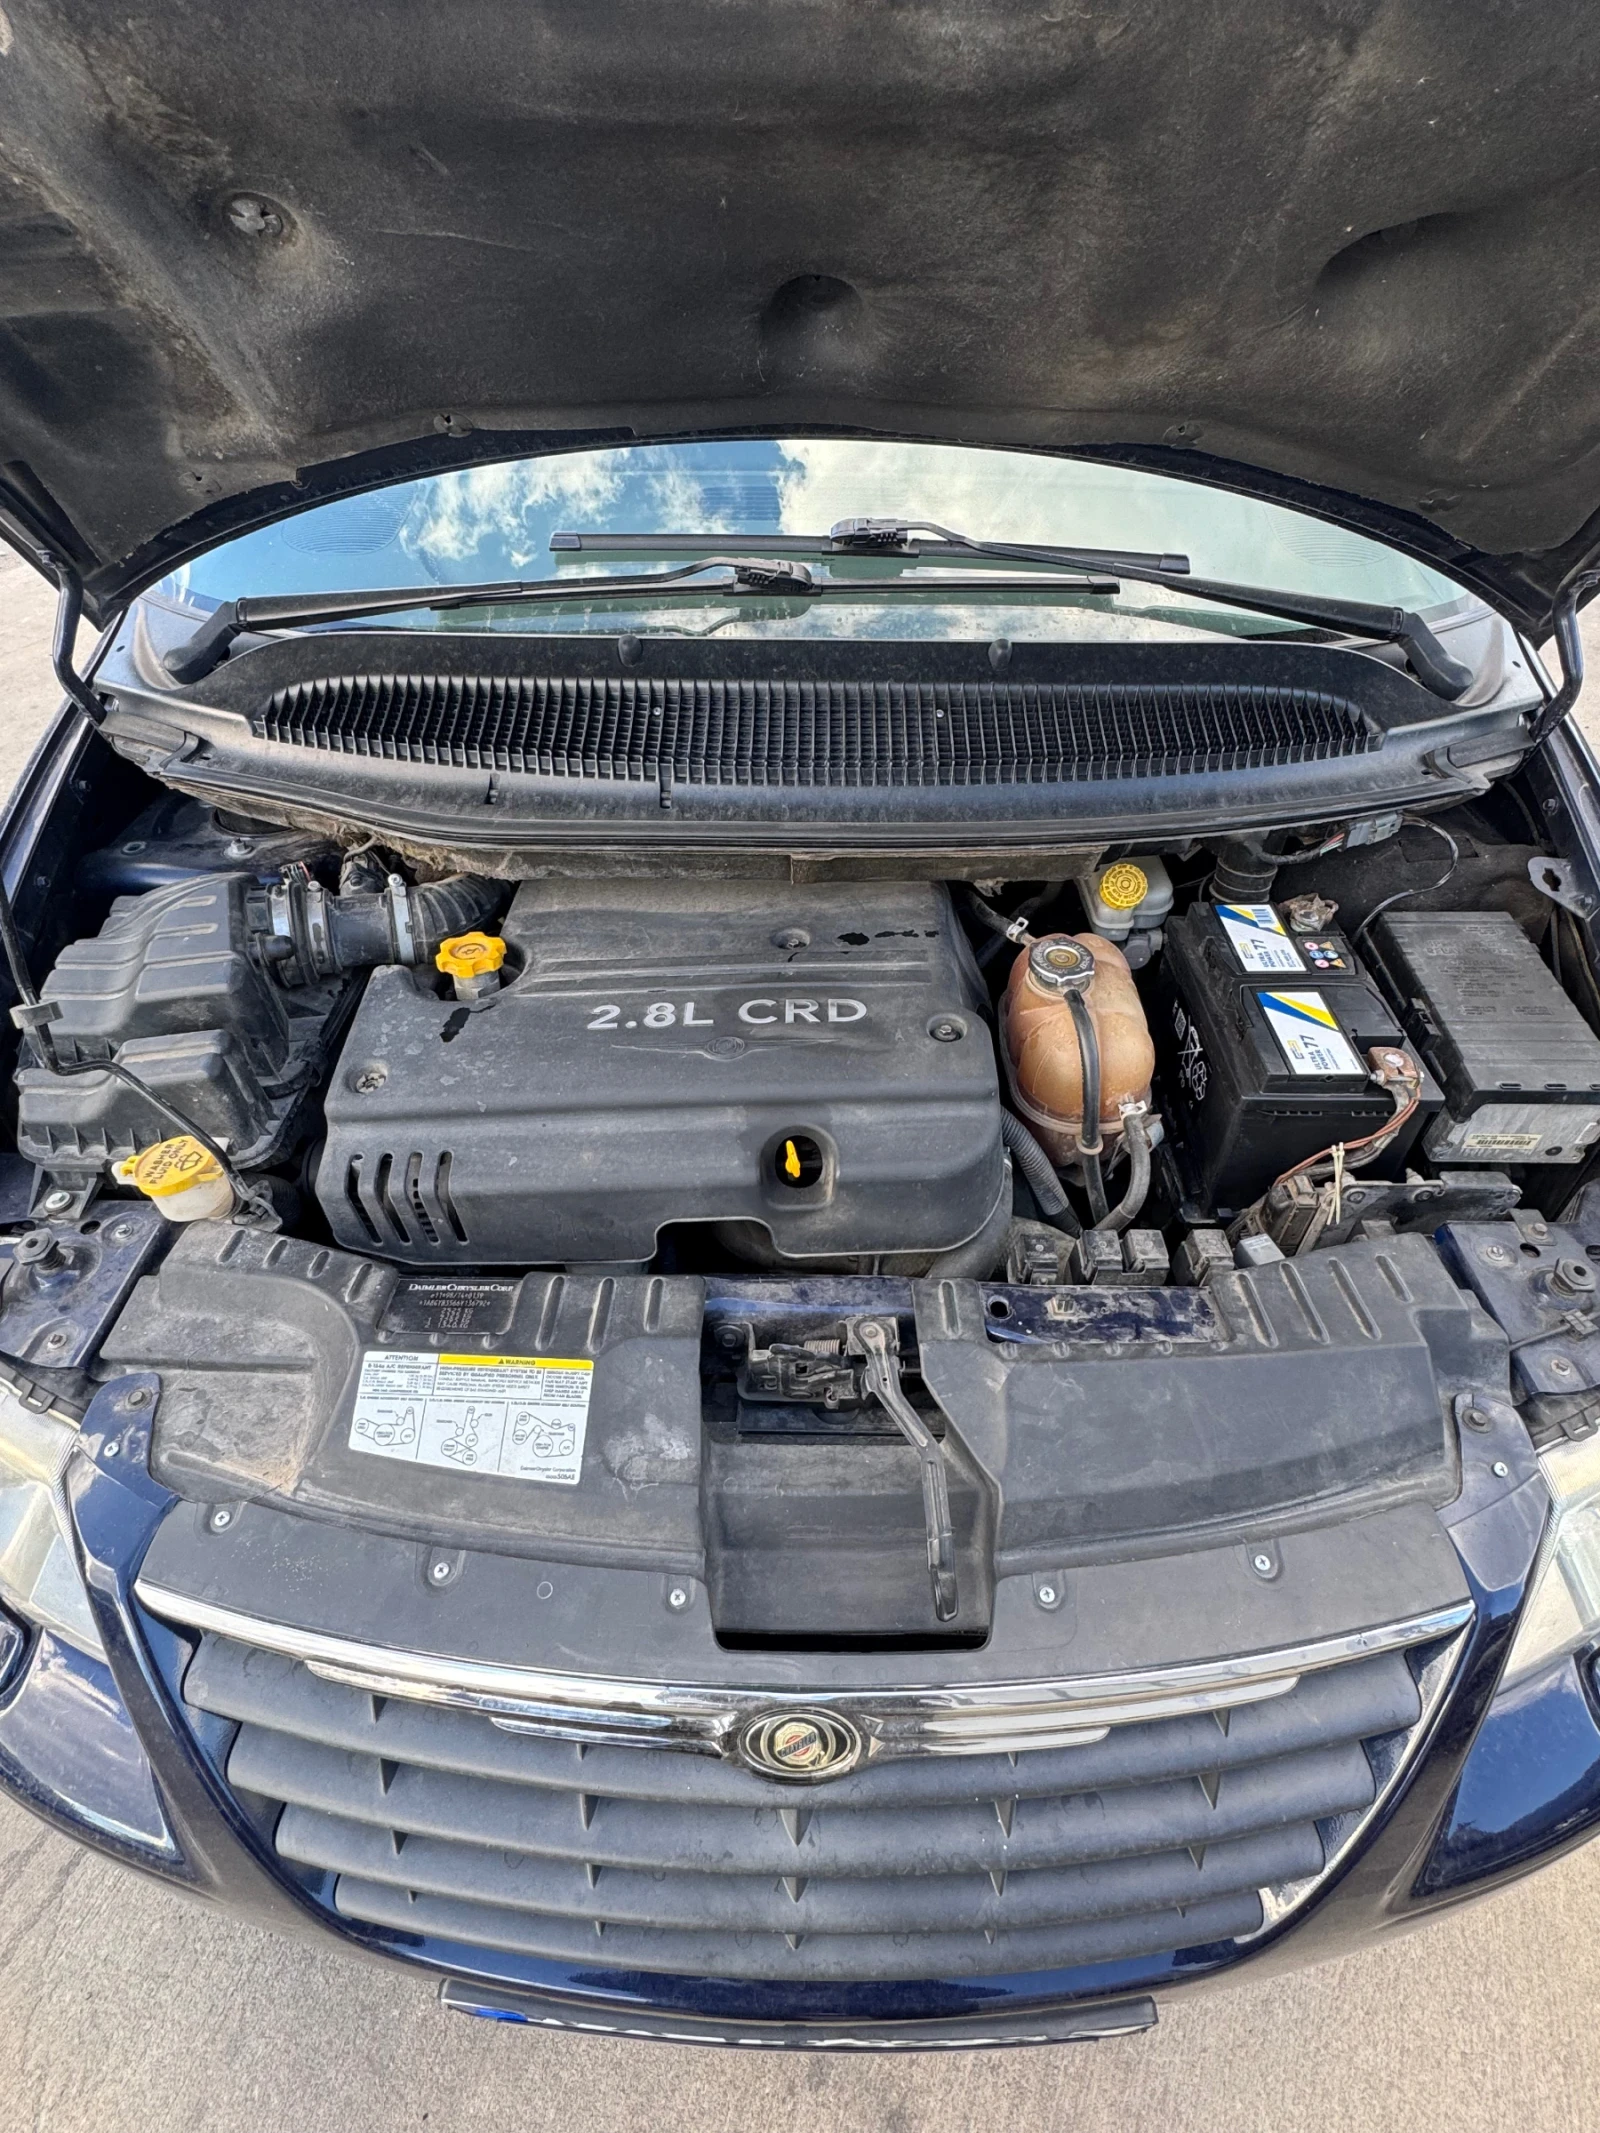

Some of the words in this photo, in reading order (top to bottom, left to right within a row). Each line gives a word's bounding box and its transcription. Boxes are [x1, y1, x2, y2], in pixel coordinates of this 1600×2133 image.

[587, 1002, 715, 1029] 2.8L
[738, 998, 868, 1024] CRD
[1299, 1034, 1319, 1049] 77
[1315, 1049, 1331, 1070] POWER
[144, 1143, 175, 1178] WASHER
[149, 1161, 173, 1184] FLUID
[168, 1139, 189, 1159] ONLY
